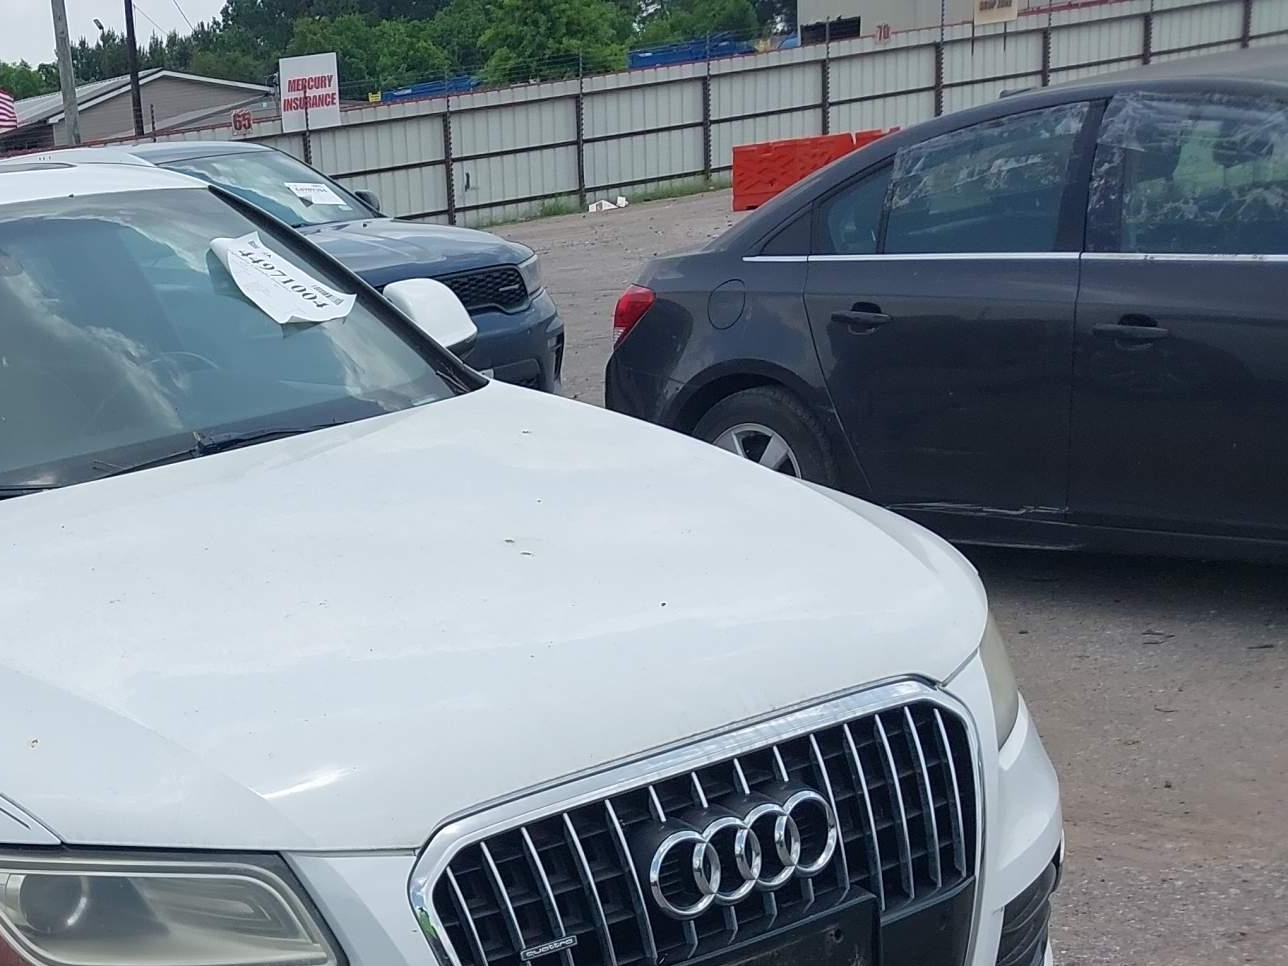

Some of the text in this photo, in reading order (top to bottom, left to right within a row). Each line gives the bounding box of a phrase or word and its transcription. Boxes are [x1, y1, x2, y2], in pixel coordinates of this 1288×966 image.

[287, 74, 333, 93] MERCURY
[283, 92, 337, 112] INSURANCE
[232, 110, 252, 131] 65
[238, 249, 329, 308] 44971004
